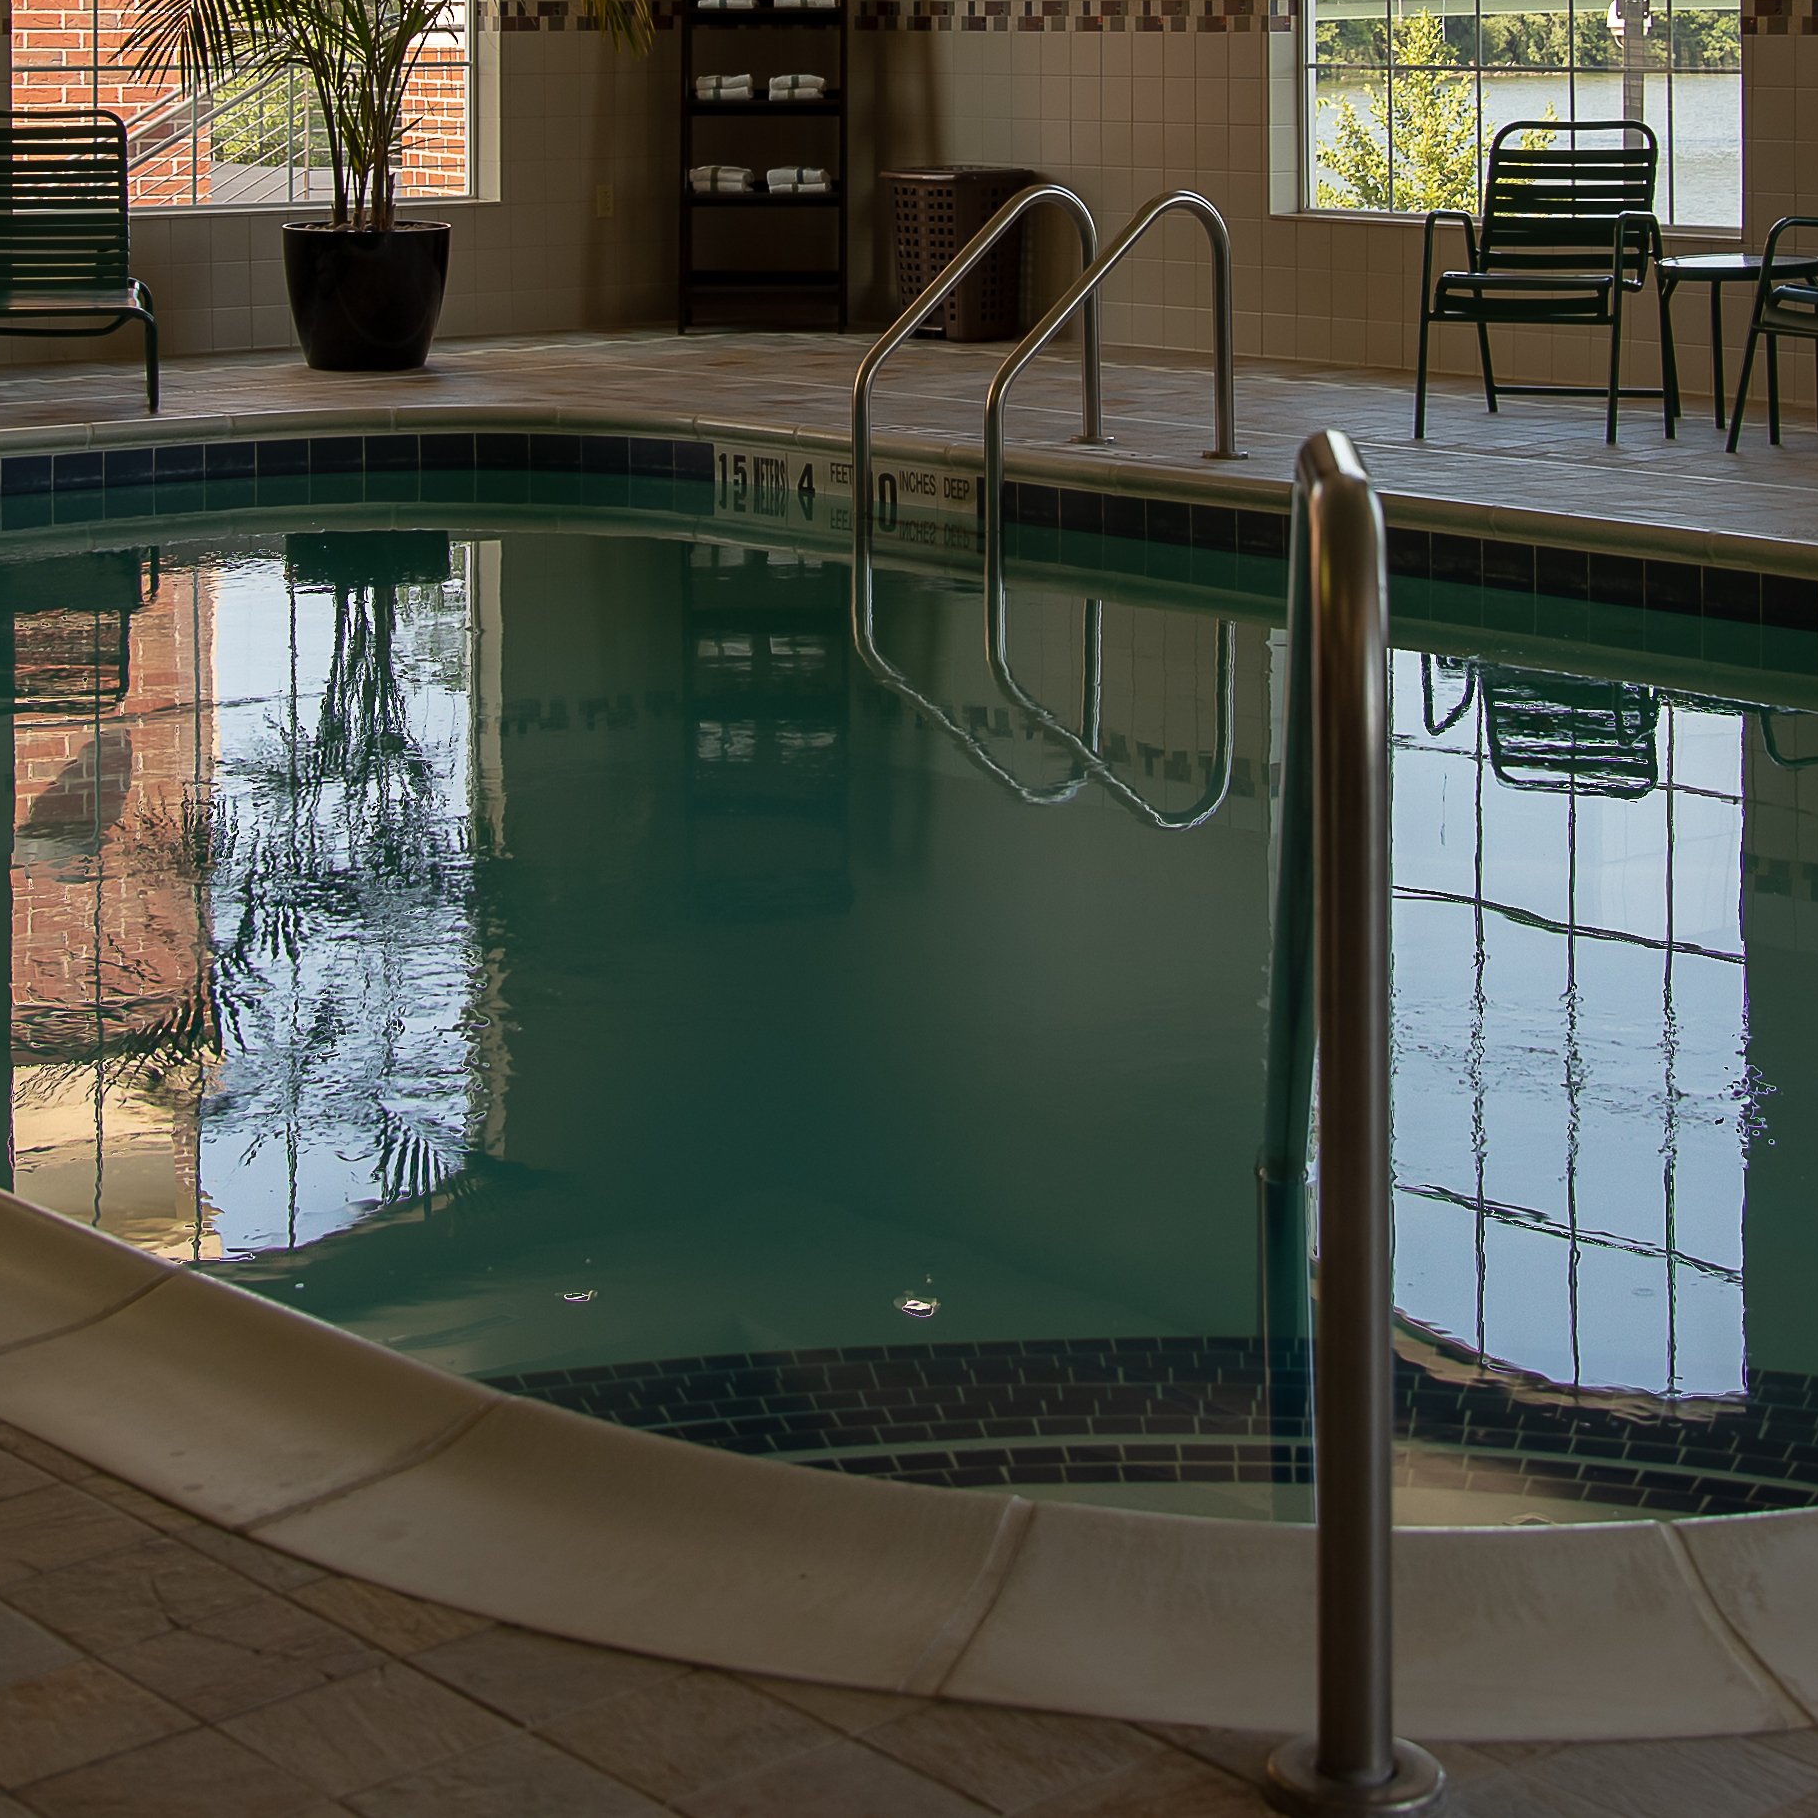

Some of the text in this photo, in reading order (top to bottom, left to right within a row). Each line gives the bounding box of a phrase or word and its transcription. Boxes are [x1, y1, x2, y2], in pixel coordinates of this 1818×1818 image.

[753, 457, 785, 490] METERS
[798, 463, 816, 493] 4
[899, 470, 936, 496] INCHES
[943, 477, 970, 500] DEEP
